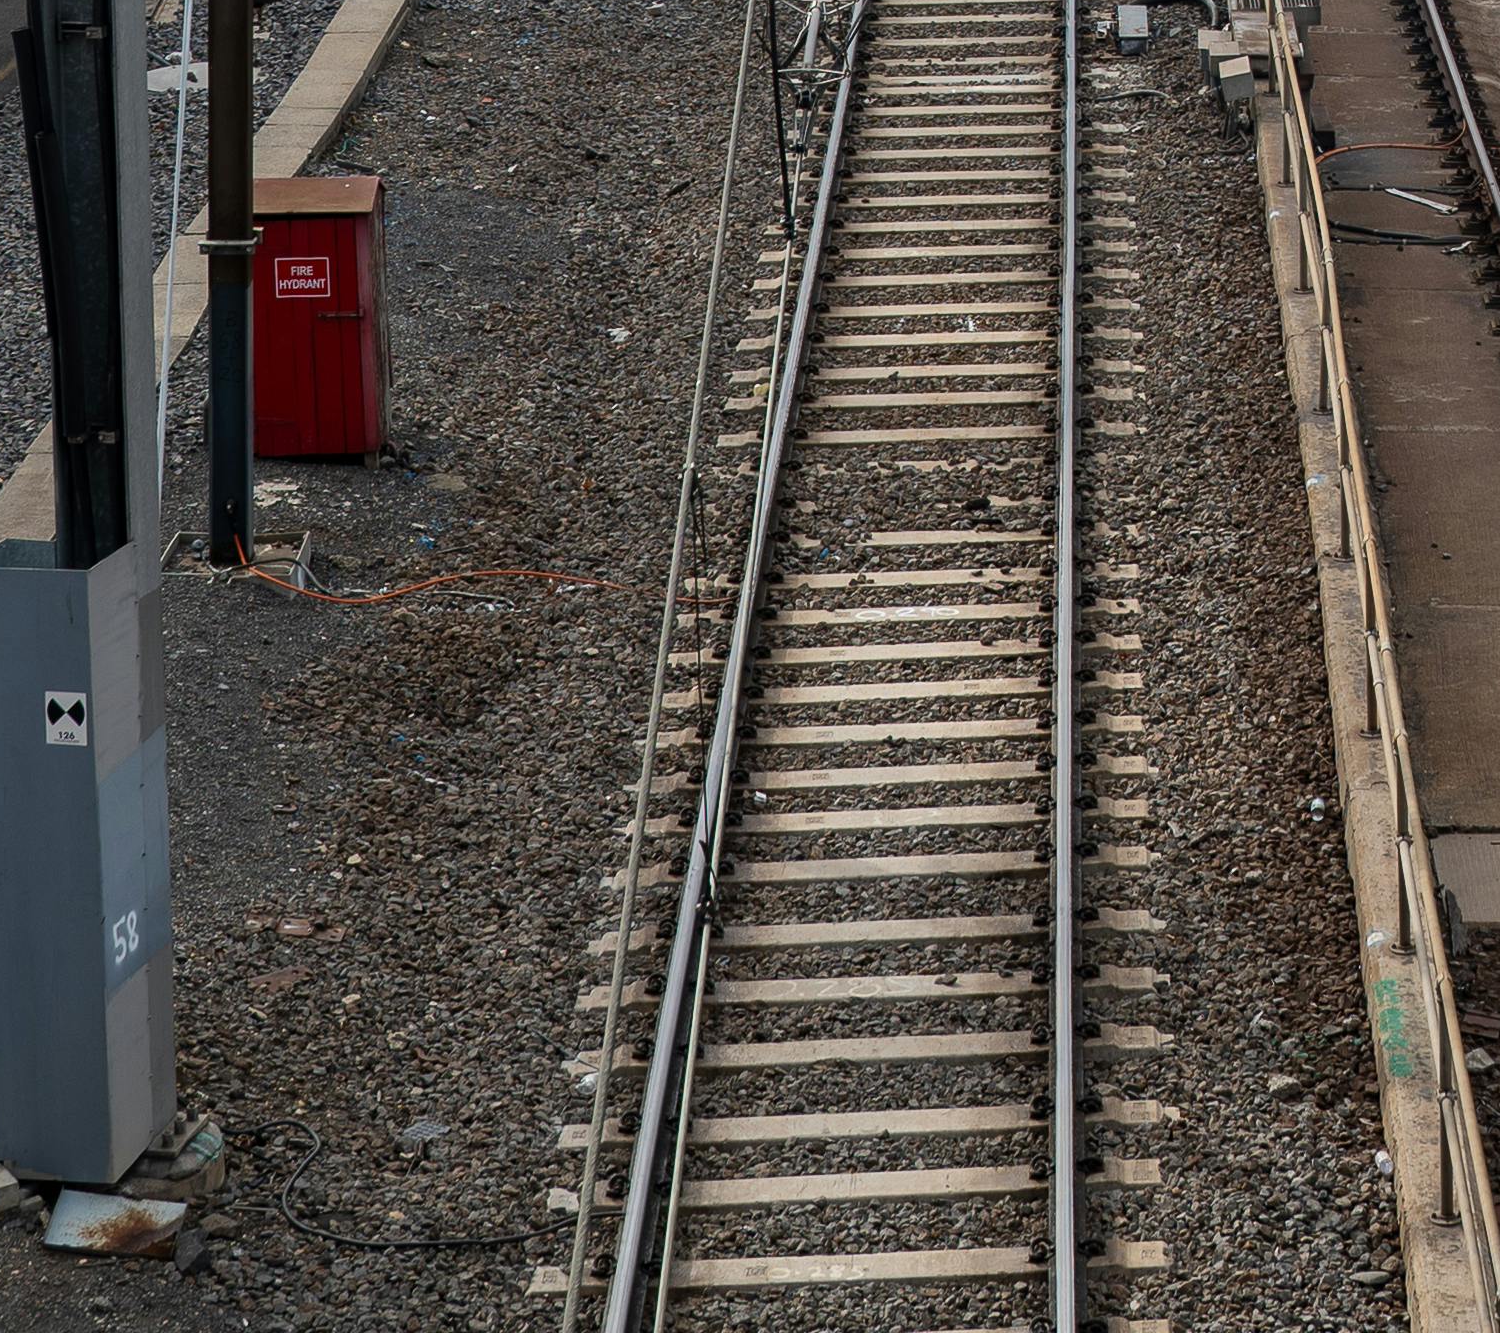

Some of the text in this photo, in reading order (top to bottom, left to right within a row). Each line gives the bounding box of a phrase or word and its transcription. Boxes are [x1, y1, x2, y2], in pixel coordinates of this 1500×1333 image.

[290, 265, 314, 277] FIRE
[279, 277, 327, 290] HYDRANT
[58, 731, 76, 740] 126
[112, 909, 140, 965] 58
